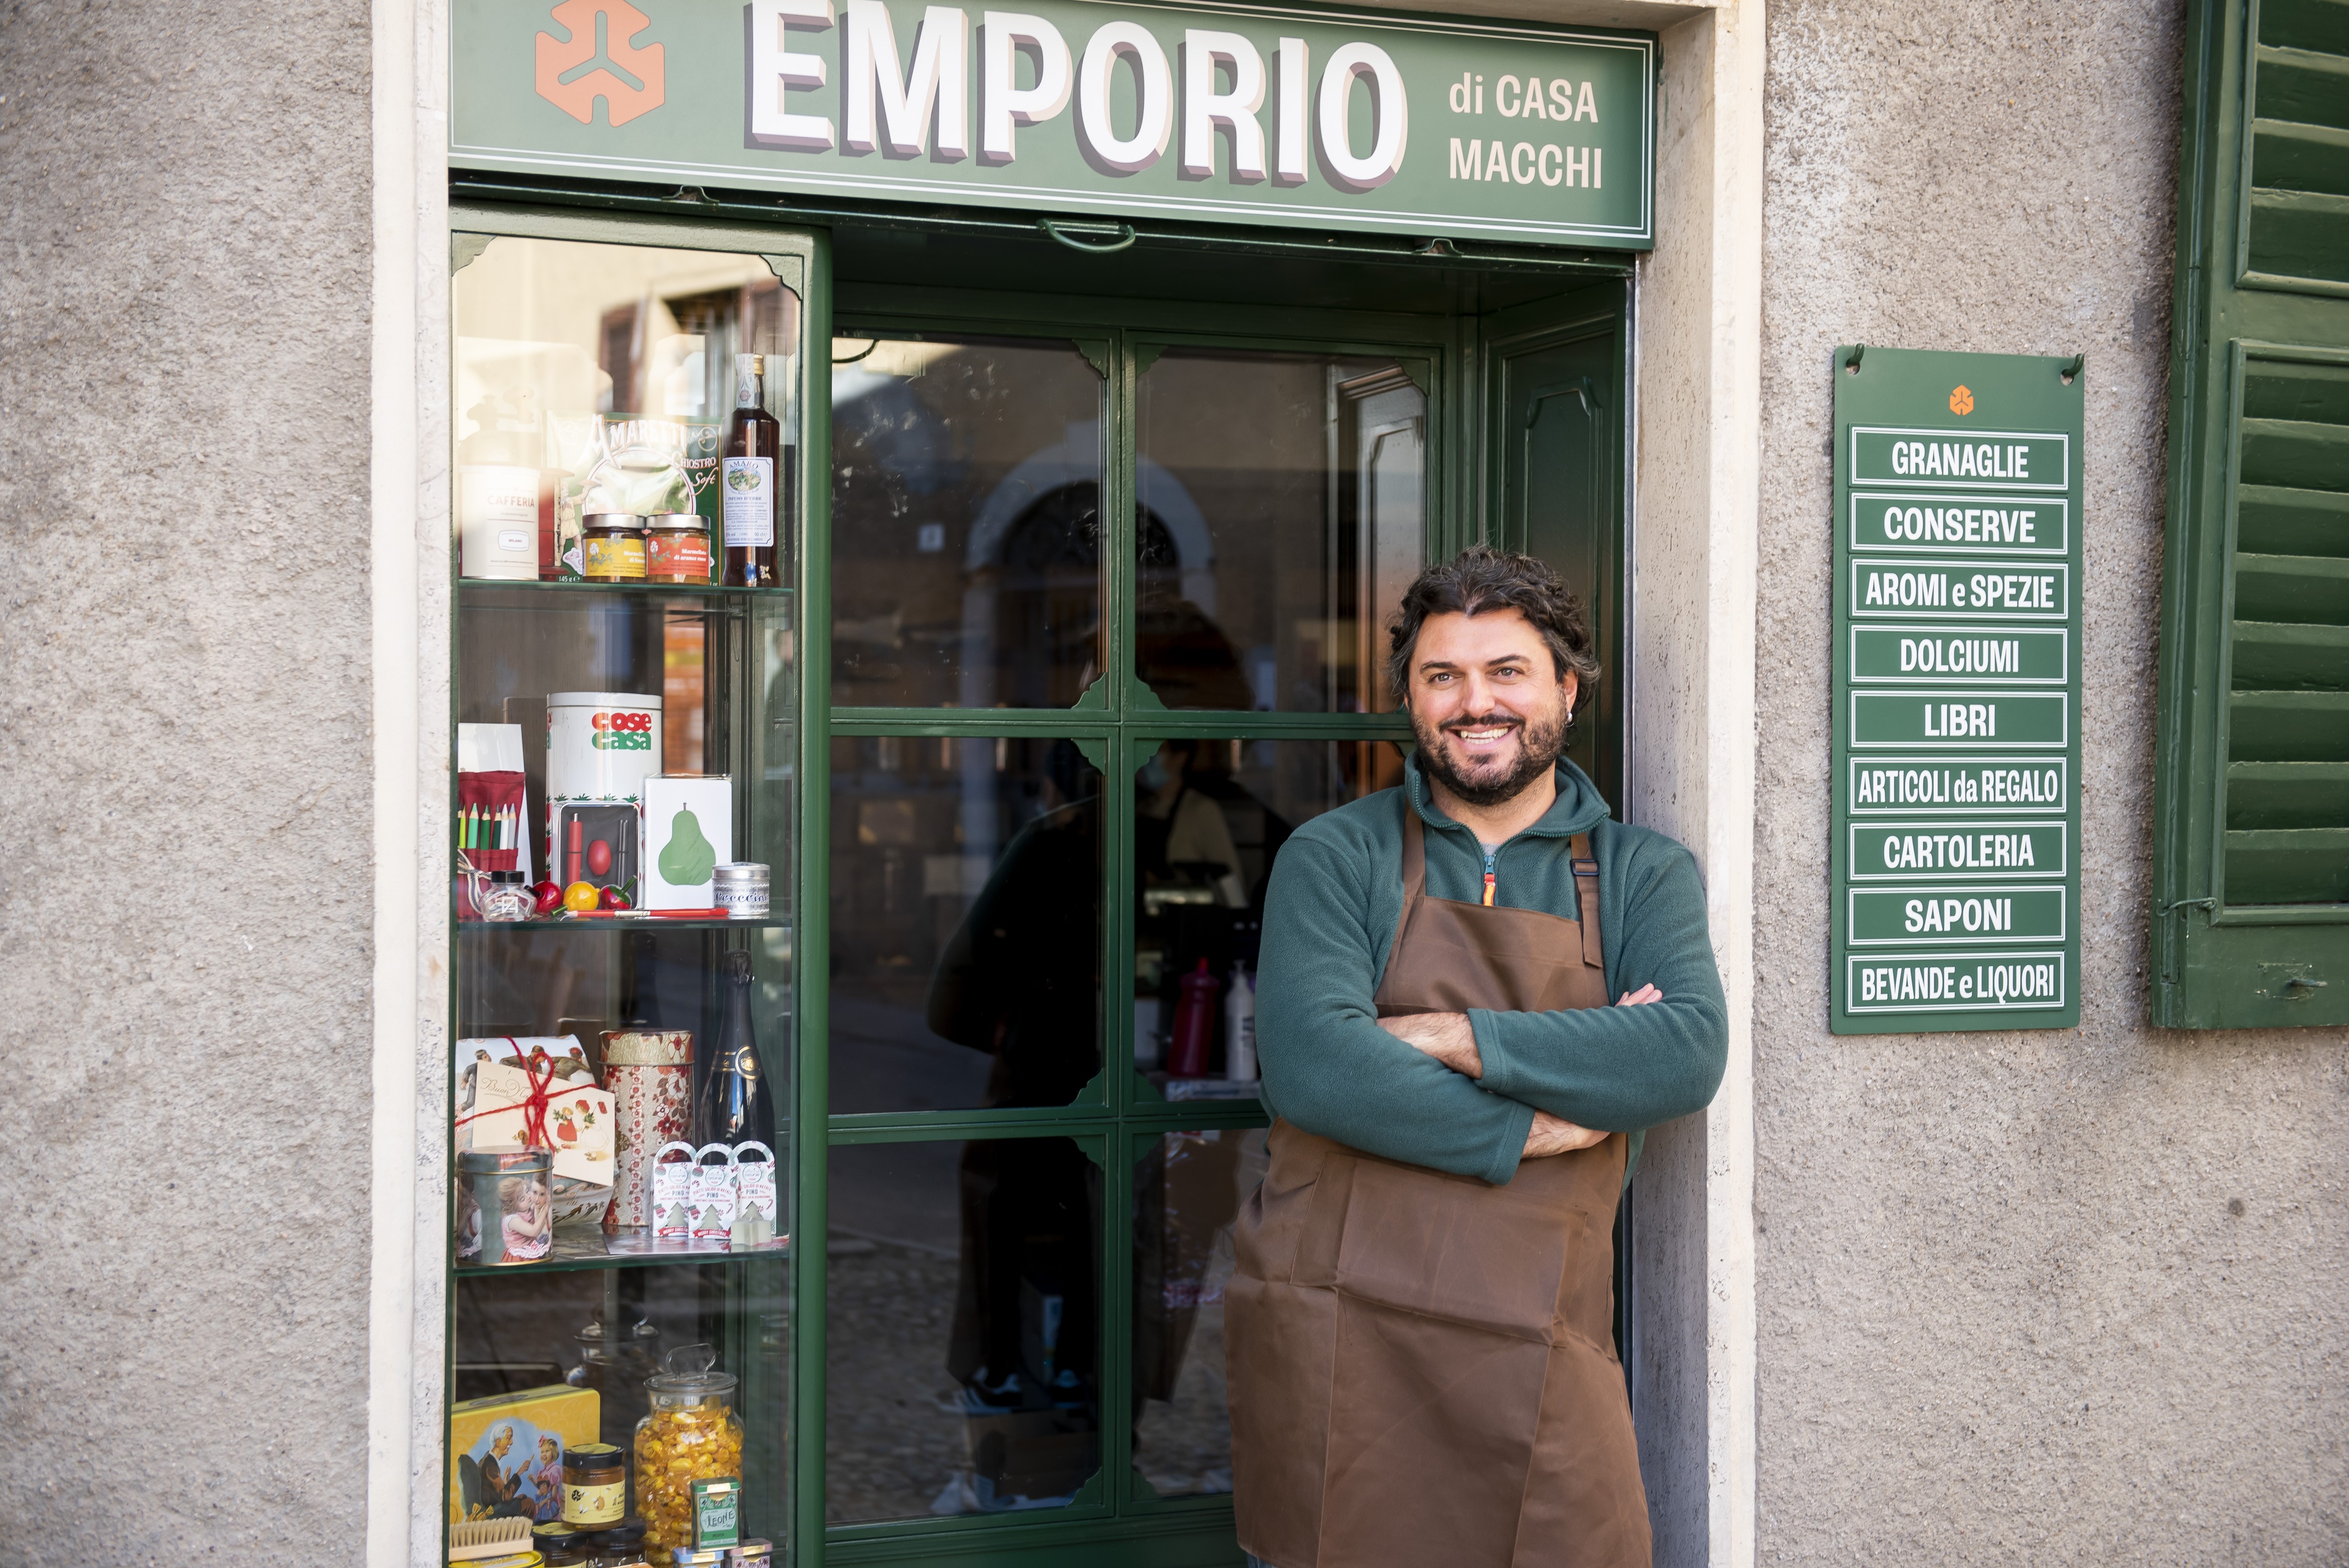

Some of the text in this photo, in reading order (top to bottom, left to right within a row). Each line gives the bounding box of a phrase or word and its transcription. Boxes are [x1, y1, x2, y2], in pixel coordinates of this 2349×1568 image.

[744, 0, 1408, 193] EMPORIO
[1449, 72, 1599, 123] di CASA
[1449, 137, 1602, 189] MACCHI
[671, 451, 717, 469] CHIOSTRO
[729, 460, 758, 469] AMARO
[1892, 441, 2029, 478] GRANAGLIE
[692, 467, 719, 496] Soft
[487, 495, 535, 508] CAFFERIA
[1884, 507, 2036, 543] CONSERVE
[1865, 572, 2054, 608] AROMI e SPEZIE
[1900, 639, 2019, 673] DOLCIUMI
[1925, 704, 1995, 736] LIBRI
[1858, 770, 2058, 803] ARTICOLI da REGALO
[1884, 834, 2035, 869] CARTOLERIA
[1905, 898, 2011, 932] SAPONI
[1862, 964, 2054, 1005] BEVANDE e LIQUORI
[480, 1077, 509, 1094] Buon
[708, 1509, 735, 1529] LEONE
